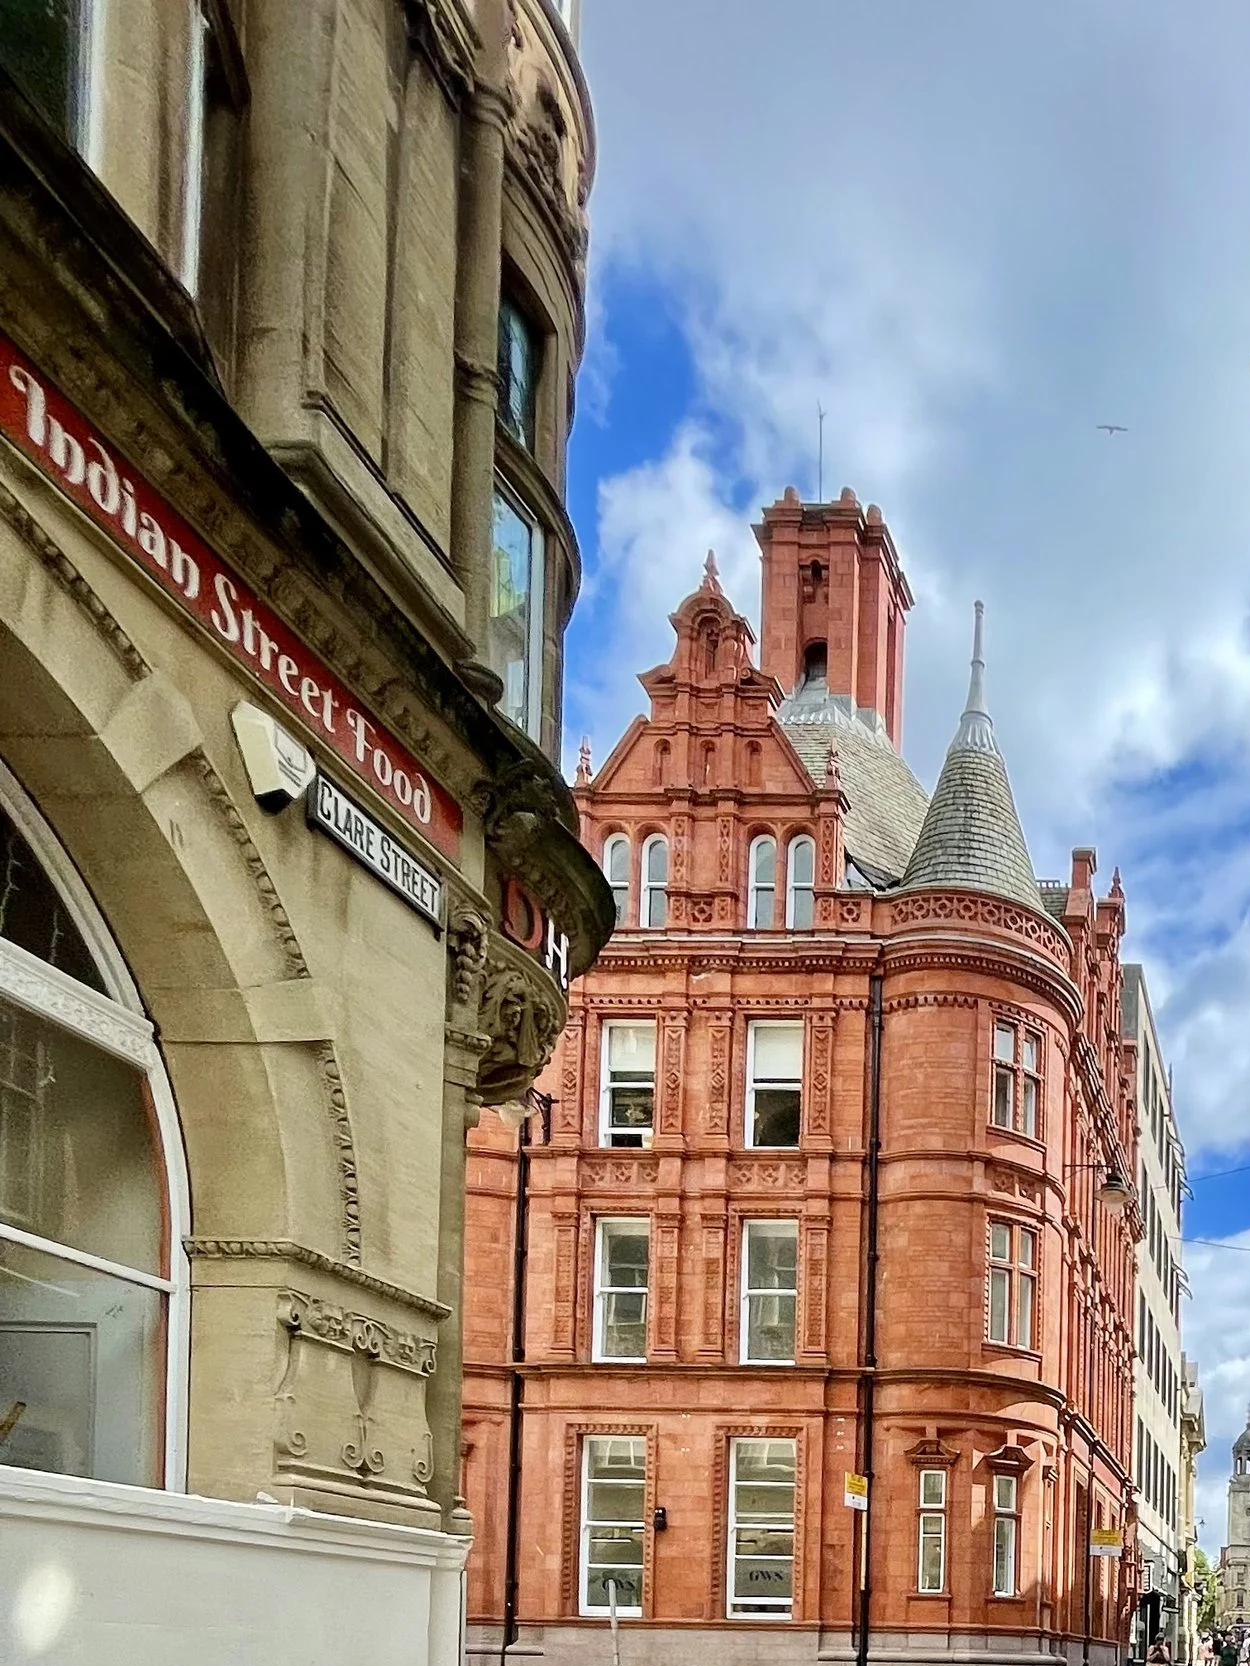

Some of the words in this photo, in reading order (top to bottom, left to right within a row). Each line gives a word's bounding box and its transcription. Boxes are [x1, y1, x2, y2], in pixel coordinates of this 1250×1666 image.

[9, 365, 200, 599] Indian
[211, 573, 339, 733] Street
[346, 709, 433, 824] Food
[318, 780, 375, 860] CLARE
[380, 837, 441, 917] STREET
